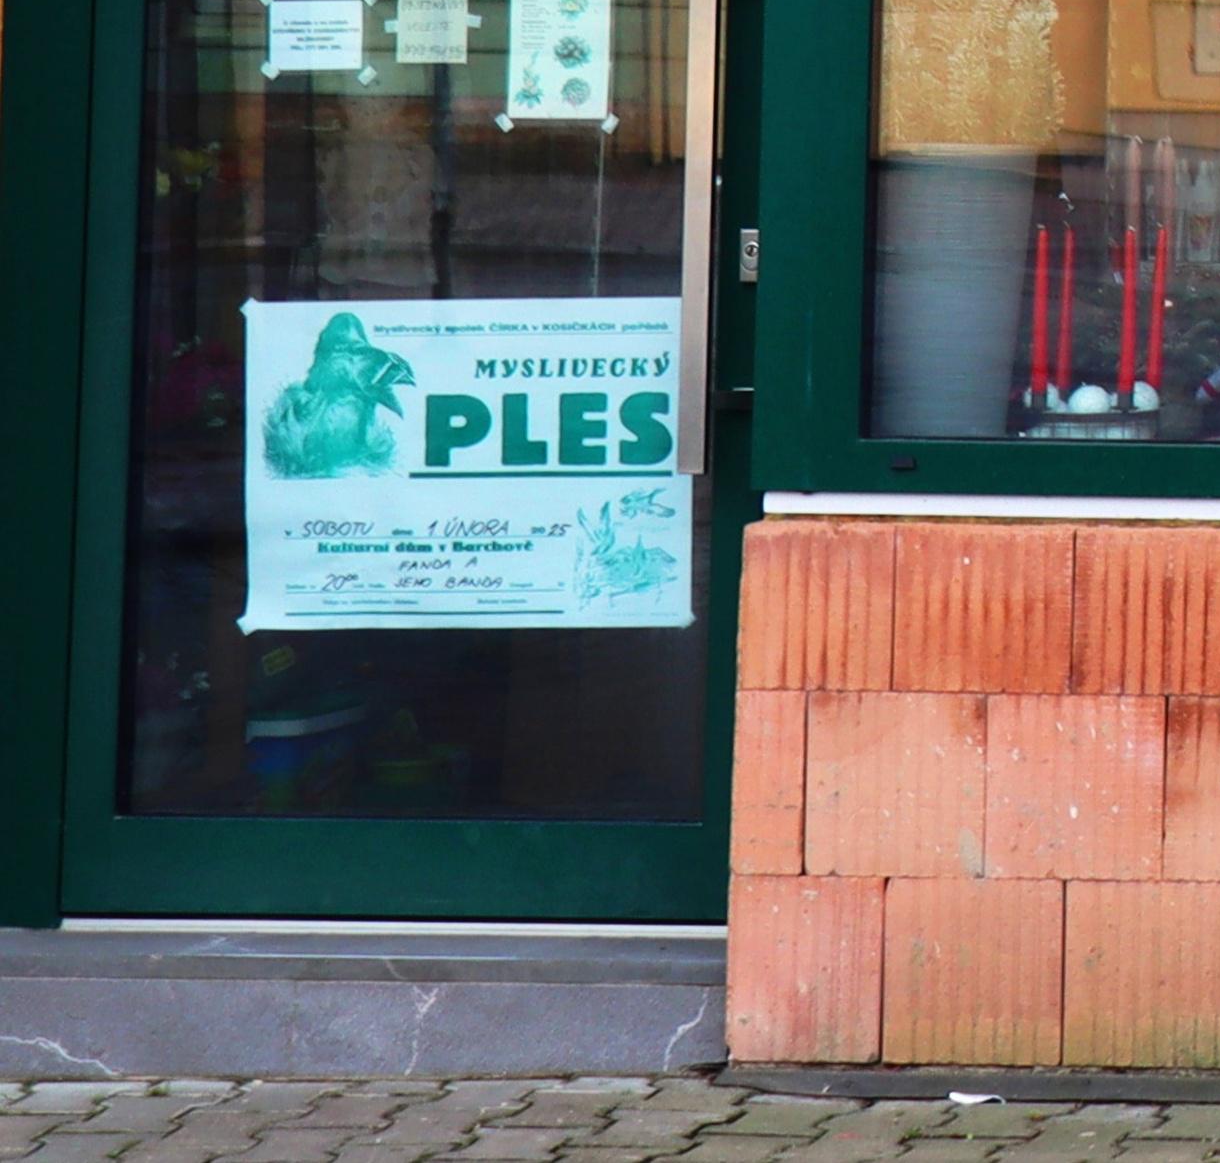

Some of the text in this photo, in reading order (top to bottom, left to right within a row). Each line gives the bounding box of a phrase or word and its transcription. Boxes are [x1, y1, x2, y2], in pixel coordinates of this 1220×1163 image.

[474, 351, 671, 379] MYSLIVECKÝ
[424, 392, 674, 467] PLES
[301, 519, 374, 538] SOBOTU
[444, 516, 509, 537] ÚNORA
